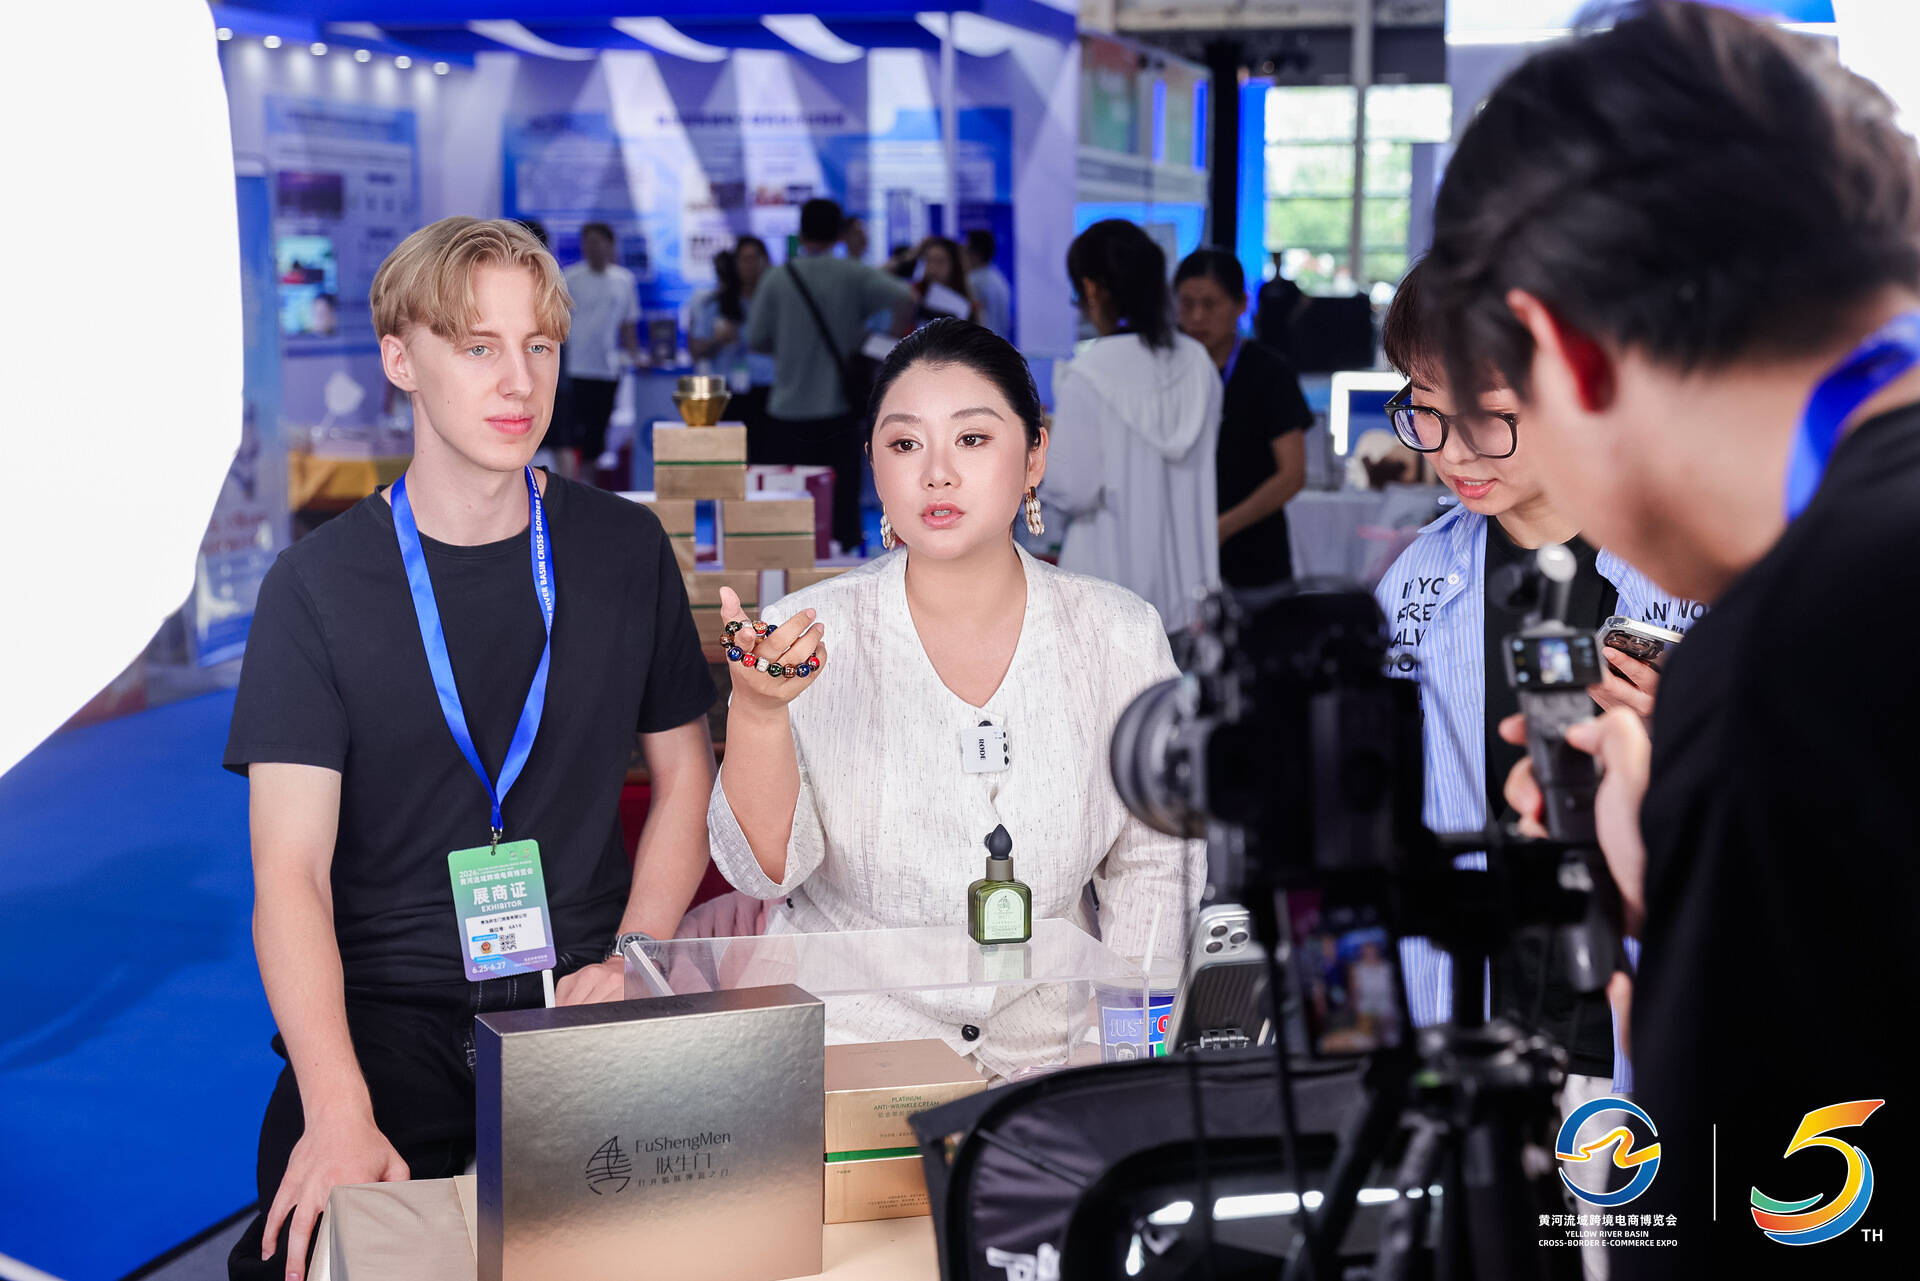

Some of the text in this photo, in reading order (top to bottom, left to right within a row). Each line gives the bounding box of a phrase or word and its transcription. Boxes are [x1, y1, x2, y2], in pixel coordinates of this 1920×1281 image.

[538, 560, 548, 585] BASIN
[539, 586, 553, 611] RIVER
[473, 881, 528, 905] 展商证
[481, 900, 523, 912] EXHIBITOR
[891, 1095, 922, 1103] PLATINUM
[635, 1131, 731, 1153] FuShengMen
